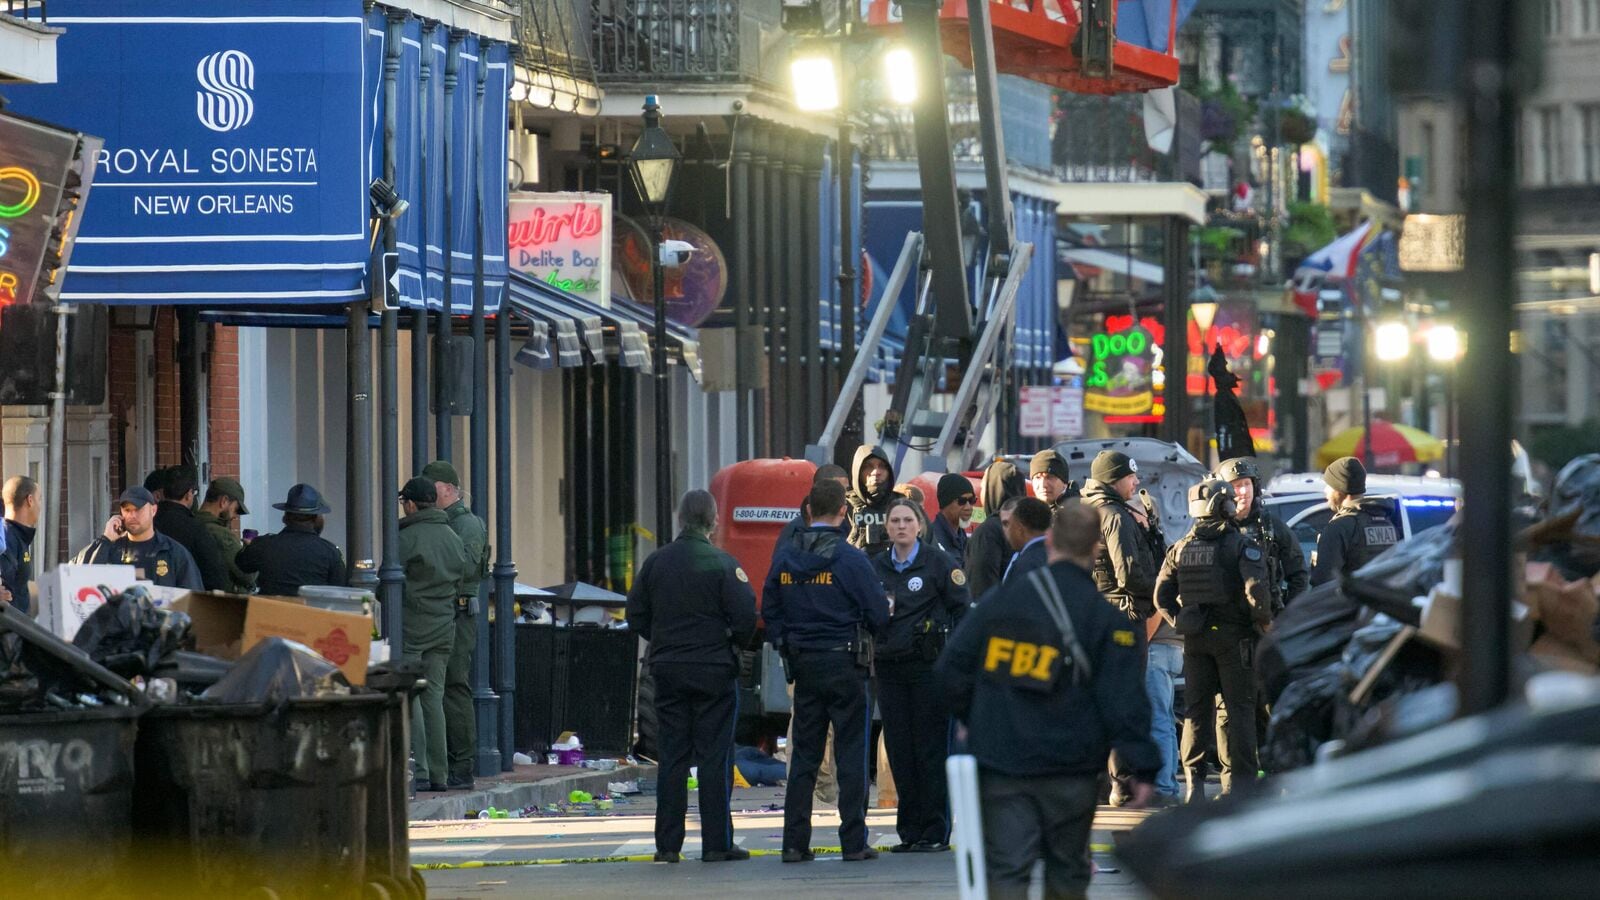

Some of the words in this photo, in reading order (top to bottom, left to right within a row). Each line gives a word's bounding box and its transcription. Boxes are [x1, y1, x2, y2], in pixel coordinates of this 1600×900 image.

[92, 148, 200, 174] ROYAL
[211, 148, 318, 174] SONESTA
[134, 195, 190, 215] NEW
[197, 194, 294, 215] ORLEANS
[520, 249, 564, 267] Delite
[572, 249, 600, 267] Bar
[984, 636, 1060, 681] FBI
